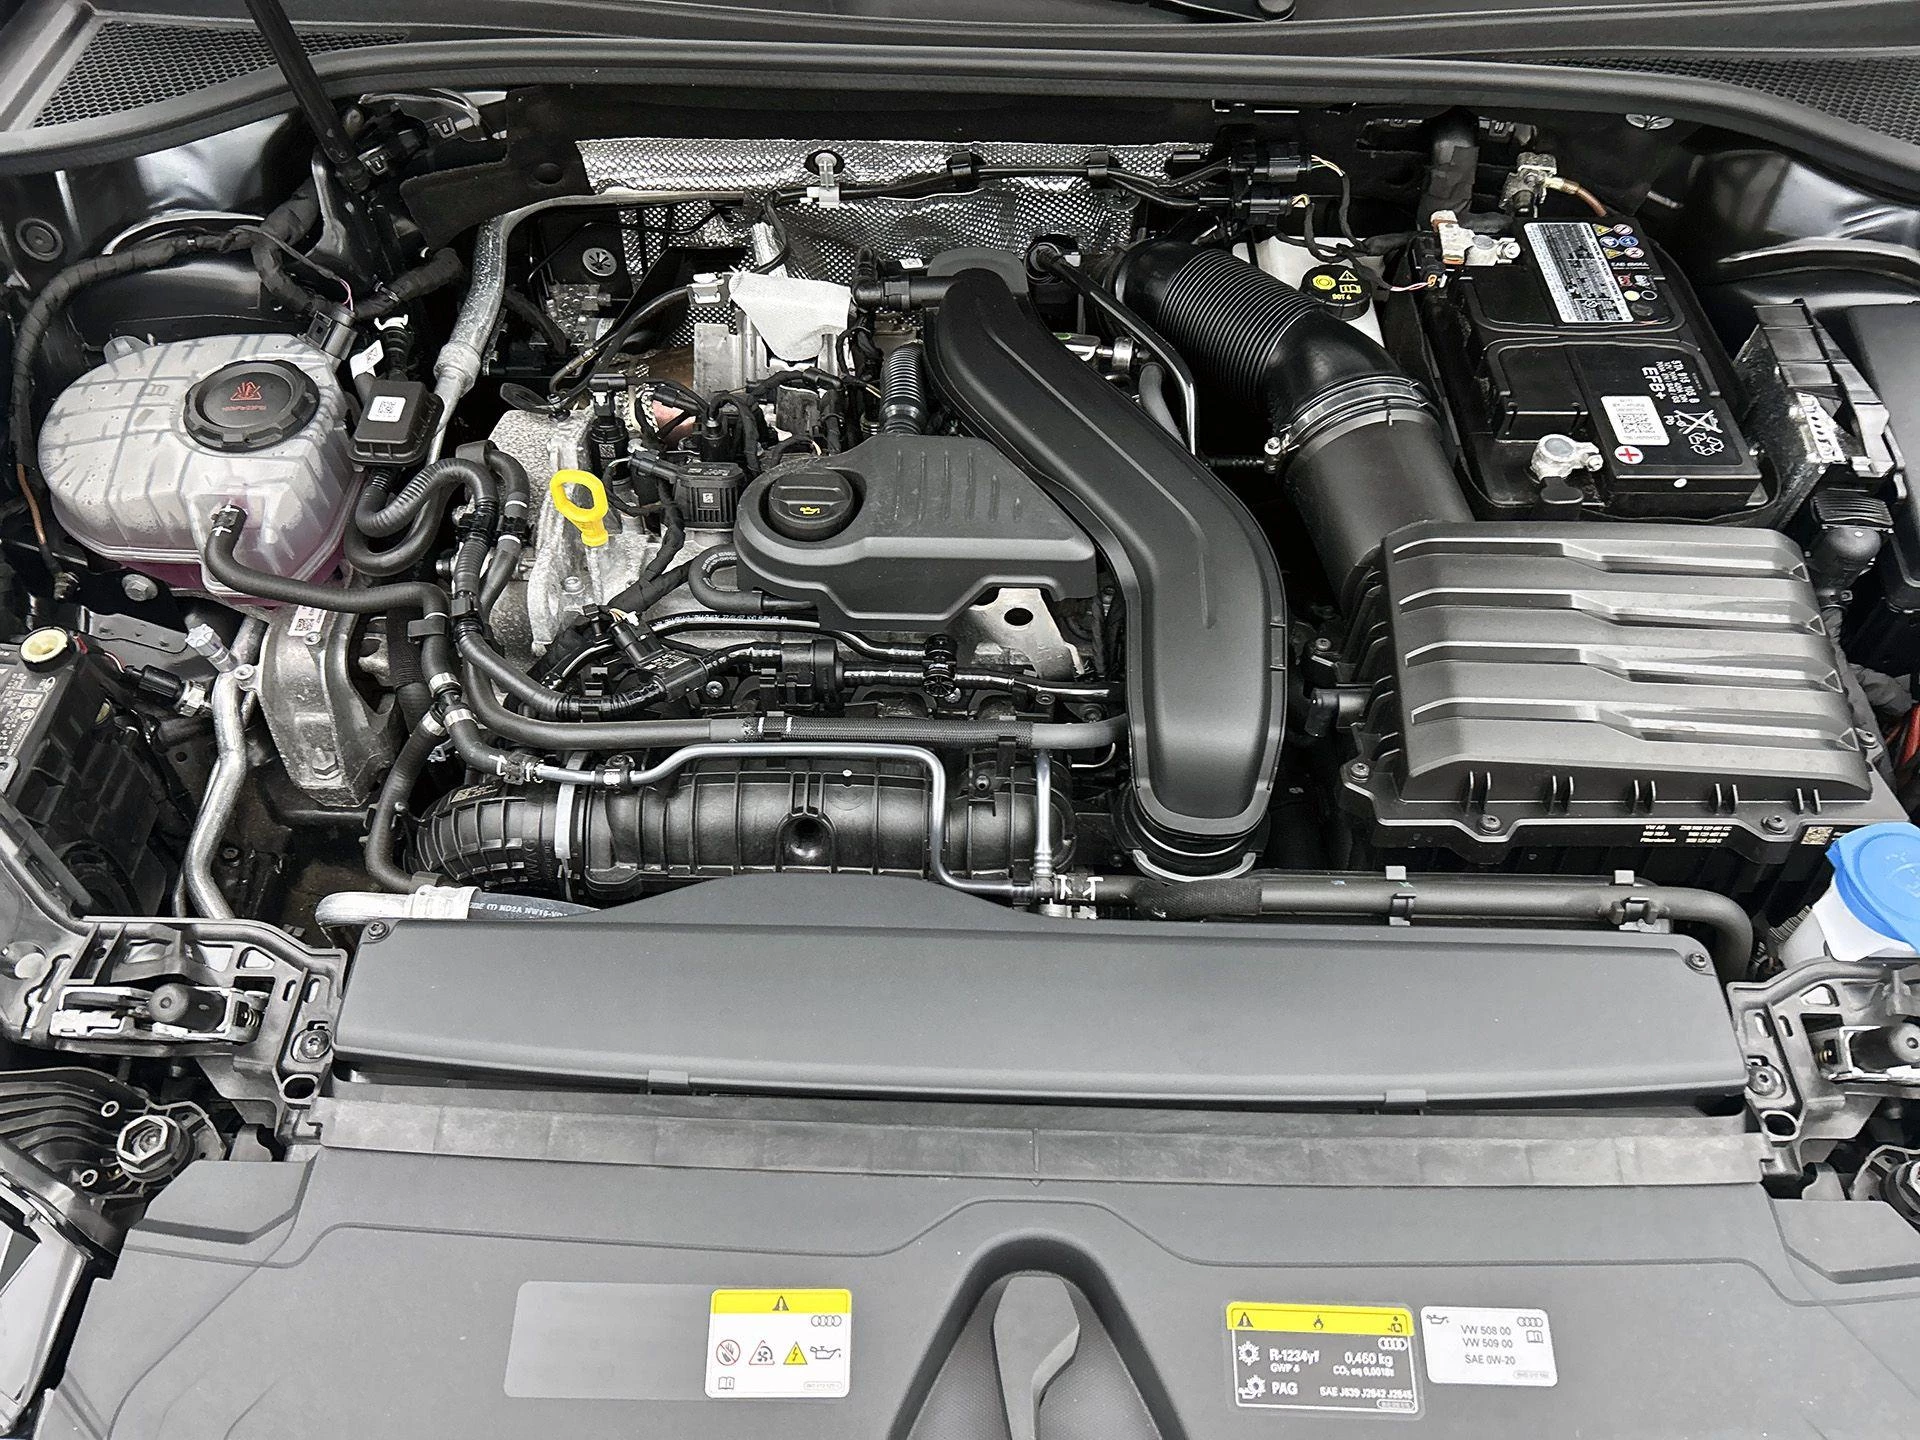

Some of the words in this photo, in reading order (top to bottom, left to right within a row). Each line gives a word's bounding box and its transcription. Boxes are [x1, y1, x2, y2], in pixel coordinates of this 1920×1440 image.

[1641, 367, 1666, 399] EFB+
[1663, 415, 1675, 425] Pb
[1460, 1325, 1478, 1335] VW
[1480, 1326, 1497, 1335] 508
[1499, 1326, 1511, 1336] 00
[1462, 1337, 1480, 1347] VW
[1482, 1338, 1499, 1348] 509
[1501, 1339, 1513, 1348] 00
[1269, 1348, 1320, 1365] R-1234yf
[1378, 1353, 1394, 1367] kg
[1465, 1354, 1484, 1364] SAE
[1486, 1355, 1516, 1365] 0W-20
[1270, 1363, 1293, 1373] GWP
[1271, 1381, 1298, 1395] PAG
[1320, 1386, 1339, 1396] SAE
